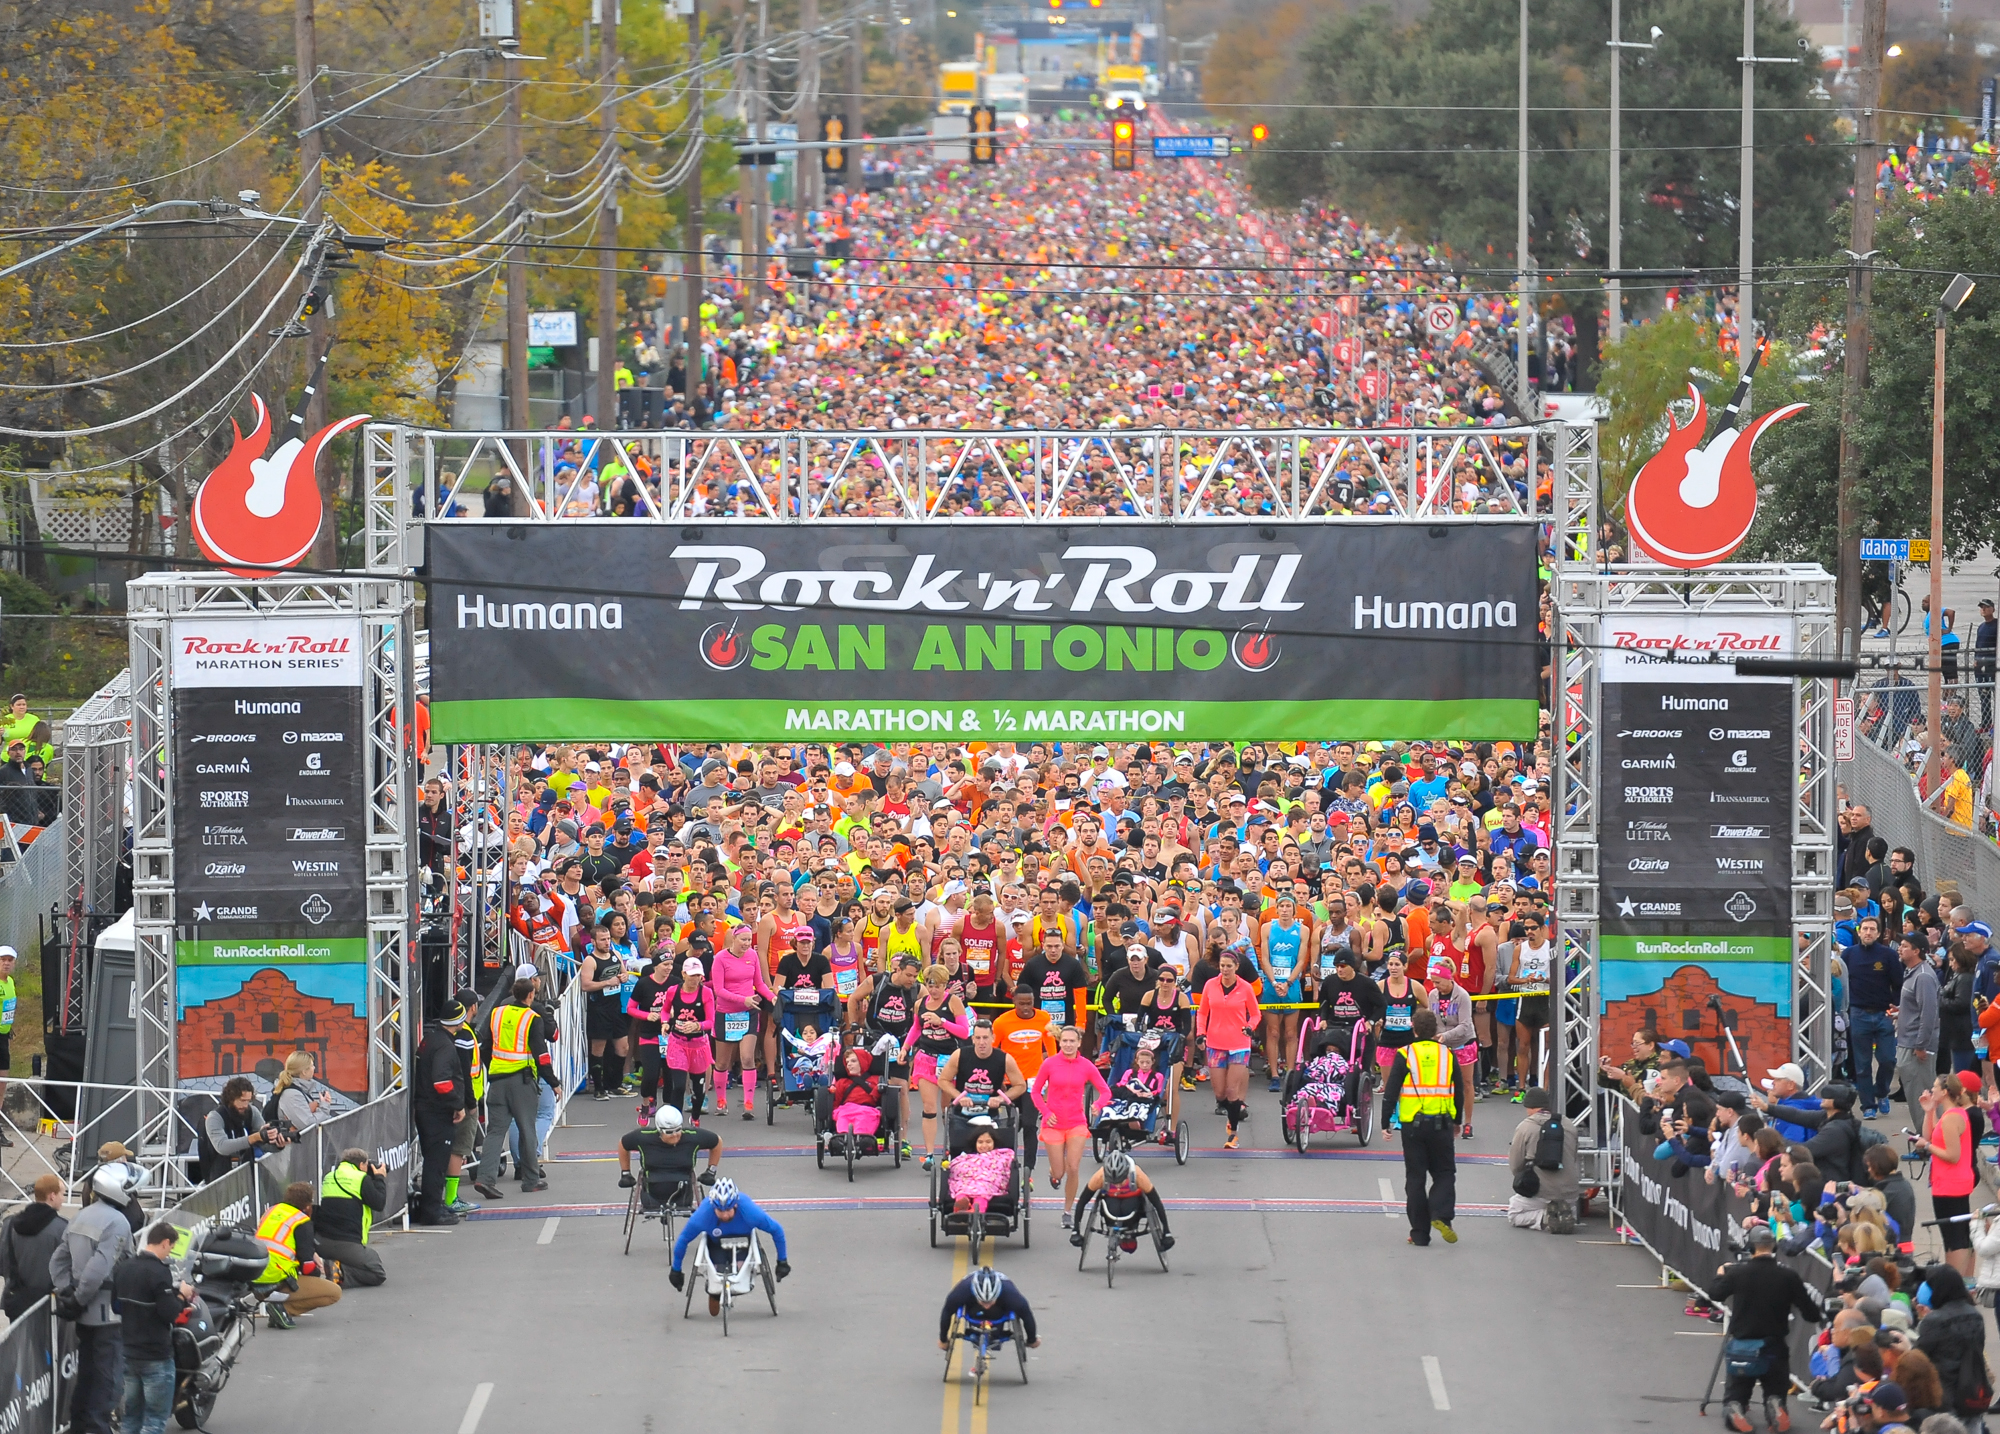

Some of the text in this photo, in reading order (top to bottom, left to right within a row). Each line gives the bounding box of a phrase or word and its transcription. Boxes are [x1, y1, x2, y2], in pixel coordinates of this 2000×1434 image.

[1320, 321, 1328, 334] 7
[1339, 349, 1349, 363] 6
[1365, 381, 1375, 395] 5
[1339, 488, 1348, 502] 4
[1861, 539, 1897, 555] Idaho
[669, 544, 970, 612] Rock
[1061, 545, 1305, 613] Roll
[457, 594, 622, 630] Humana
[1355, 595, 1517, 630] Humana
[182, 636, 261, 654] Rock
[287, 636, 350, 654] Roll
[750, 623, 1227, 671] SAN ANTONIO
[1612, 632, 1691, 650] Rock
[1717, 632, 1781, 650] Roll
[196, 659, 282, 669] MARATHON
[235, 699, 301, 714] Humana
[1661, 695, 1729, 710] Humana
[784, 708, 953, 731] MARATHON
[959, 708, 982, 732] &
[1023, 708, 1185, 732] MARATHON
[206, 734, 257, 743] BROOKS
[1631, 729, 1683, 738] BROOKS
[196, 763, 250, 774] GARMIN
[1621, 759, 1676, 769] GARMIN
[200, 791, 249, 801] SPORTS
[1624, 786, 1673, 797] SPORTS
[200, 800, 249, 808] AUTHORITY
[293, 828, 338, 839] PowerBar
[1626, 830, 1672, 841] ULTRA
[1717, 825, 1764, 837] PowerBar
[202, 834, 248, 845] ULTRA
[204, 863, 246, 875] Ozarka
[291, 860, 339, 871] WESTIN
[1628, 858, 1670, 871] Ozarka
[1716, 858, 1763, 869] WESTIN
[216, 906, 258, 915] GRANDE
[1640, 902, 1682, 911] GRANDE
[964, 938, 994, 948] SOLER'S
[1636, 941, 1754, 955] RunRocknRoll.com
[213, 944, 330, 958] RunRocknRoll.com
